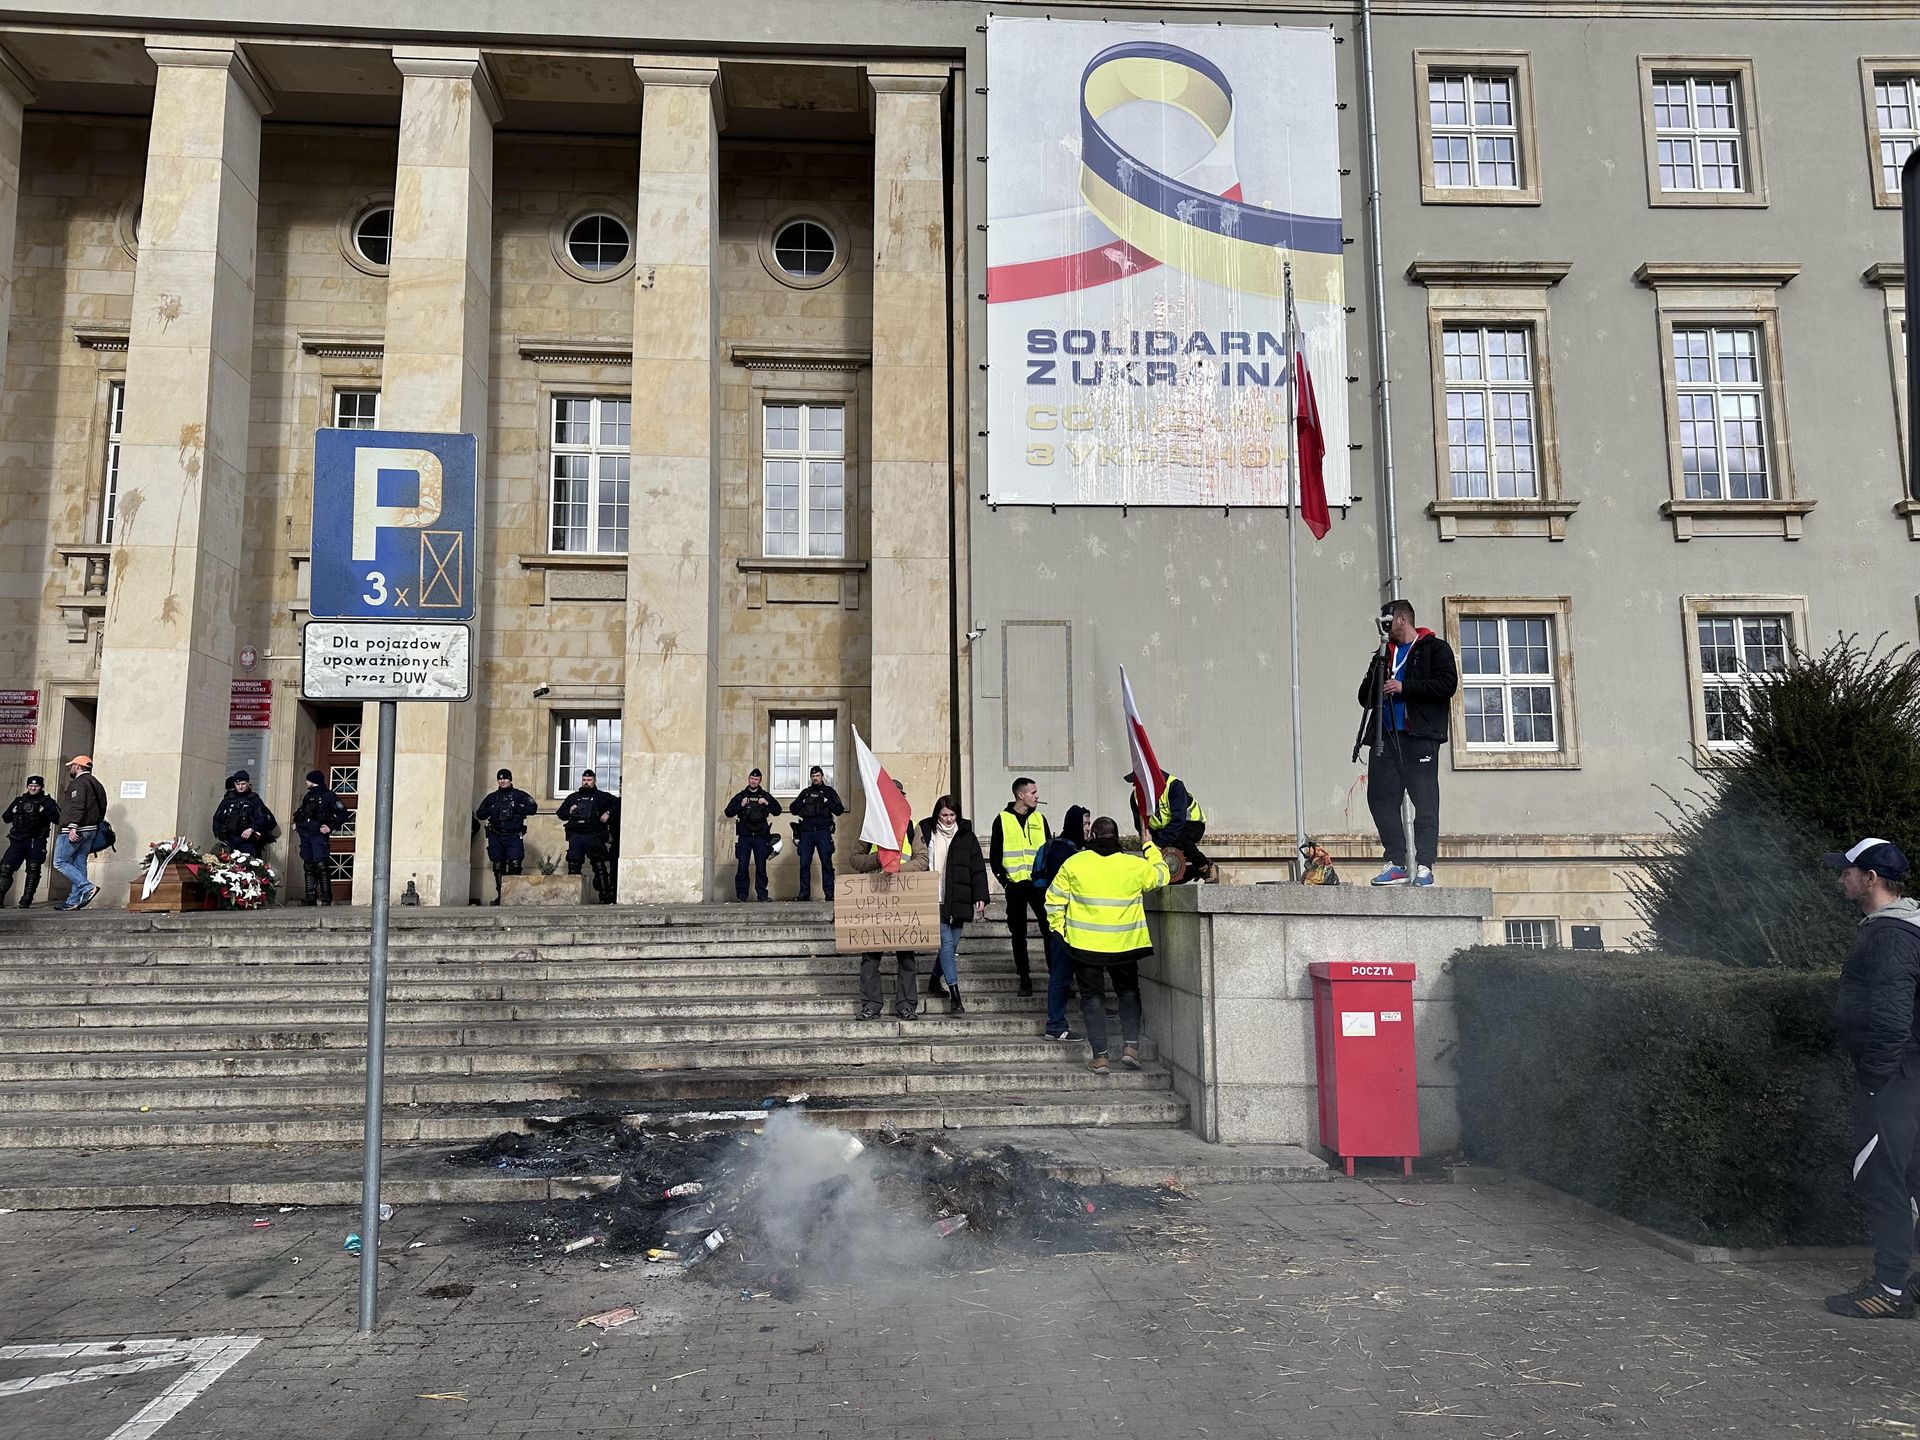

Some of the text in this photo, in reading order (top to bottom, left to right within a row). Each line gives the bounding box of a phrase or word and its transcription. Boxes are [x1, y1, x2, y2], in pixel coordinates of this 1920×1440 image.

[1027, 329, 1306, 356] SOLIDARN
[1026, 360, 1056, 385] Z
[351, 447, 443, 561] P
[362, 571, 388, 606] 3
[332, 635, 441, 652] Dla pojazdów
[323, 653, 449, 672] upoważnionych
[392, 672, 427, 684] DUW
[842, 875, 920, 896] STUDENCI
[857, 896, 900, 909] UPWR
[844, 911, 921, 927] WSPIERAJĄ
[849, 926, 930, 945] ROLNIKÓW
[1351, 966, 1394, 976] POCZTA
